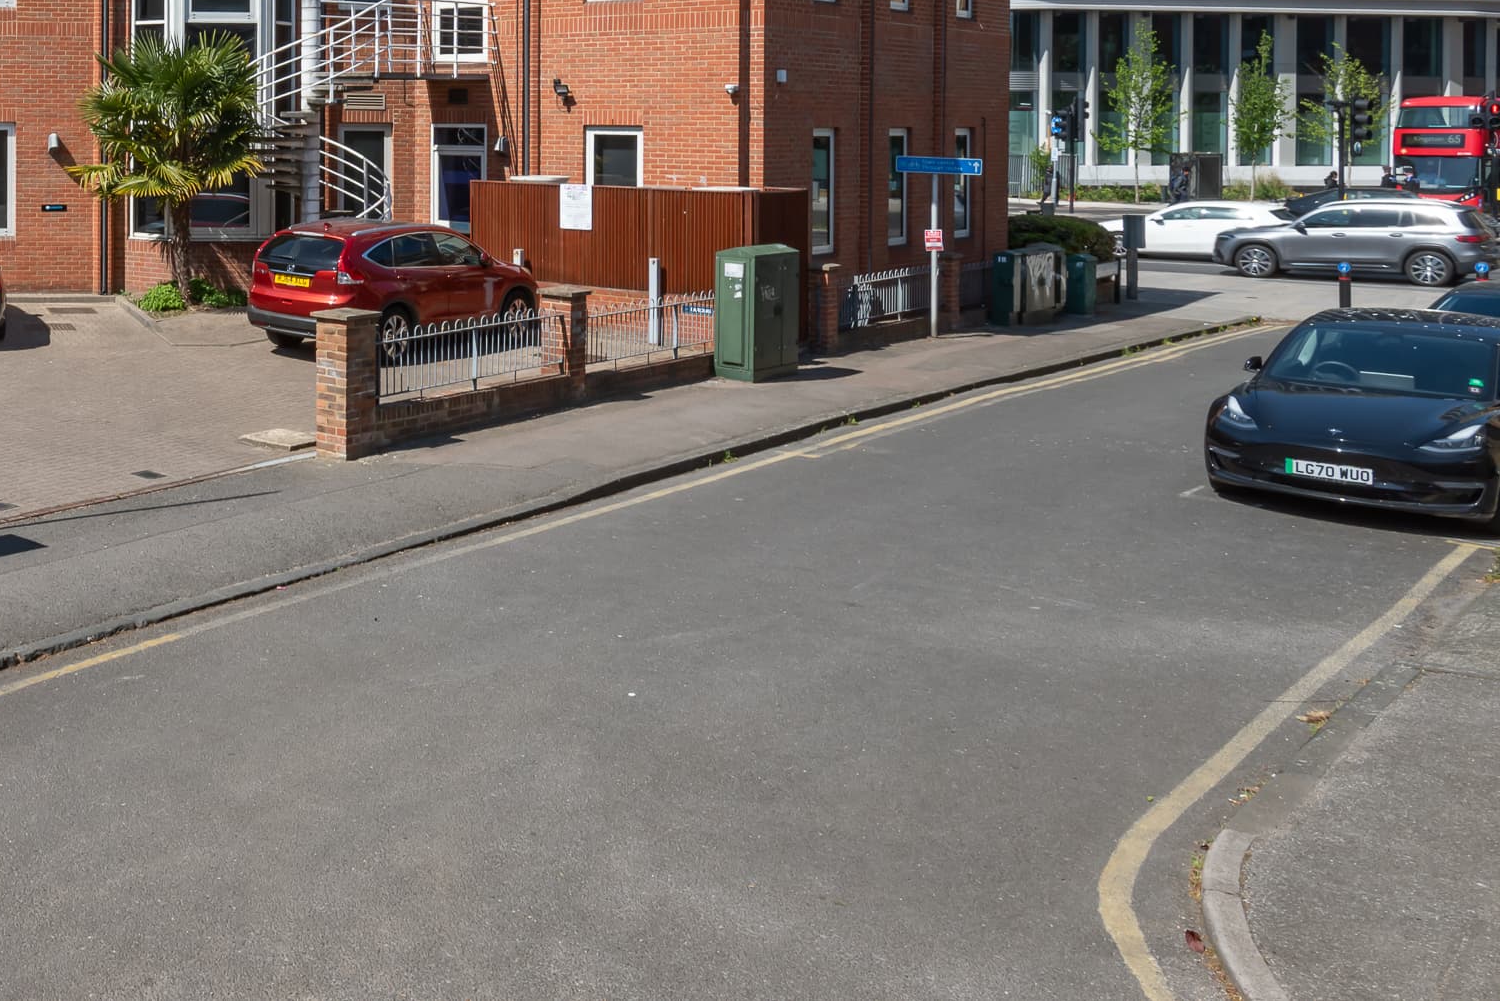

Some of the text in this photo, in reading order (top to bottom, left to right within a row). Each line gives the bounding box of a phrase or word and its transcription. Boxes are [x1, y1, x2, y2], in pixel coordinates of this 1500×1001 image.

[1447, 135, 1460, 143] 65
[1295, 462, 1370, 482] LG70 WUO
